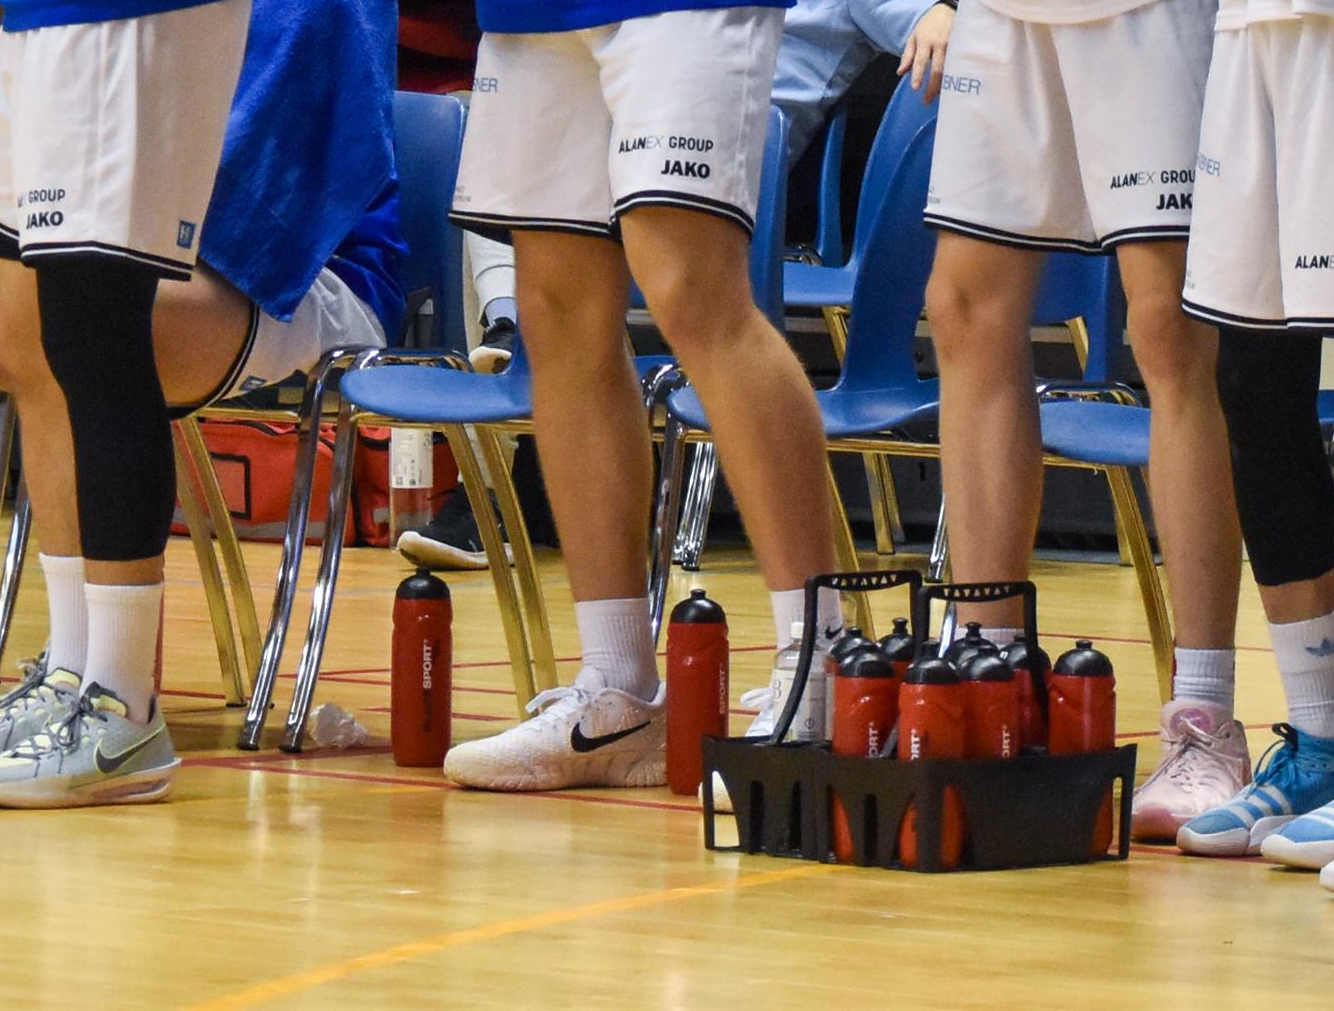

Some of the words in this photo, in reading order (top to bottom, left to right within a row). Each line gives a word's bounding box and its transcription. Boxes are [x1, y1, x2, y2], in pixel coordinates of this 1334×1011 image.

[618, 136, 664, 154] ALANEX
[668, 136, 714, 152] GROUP
[660, 160, 711, 179] JAKO
[1110, 172, 1155, 189] ALANEX
[1160, 170, 1195, 184] GROU
[28, 188, 66, 204] GROUP
[1156, 193, 1193, 210] JAK
[26, 210, 64, 230] JAKO
